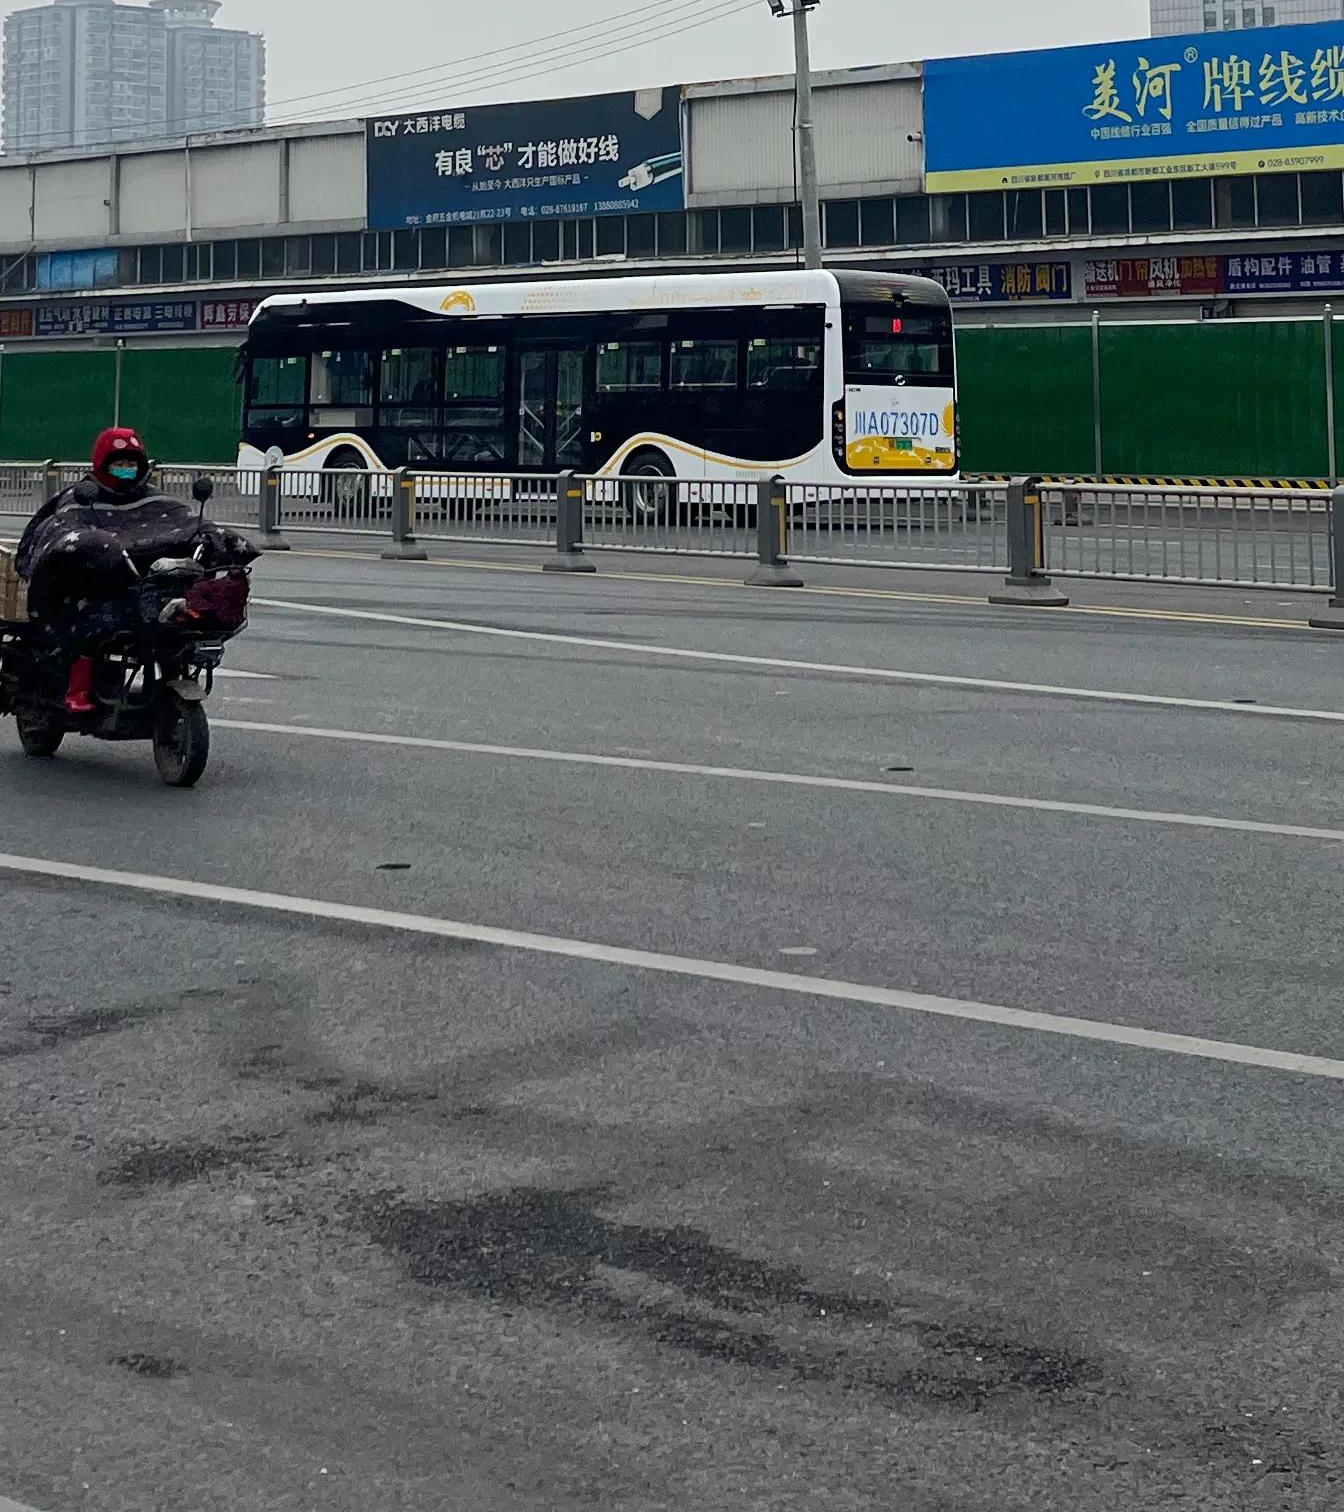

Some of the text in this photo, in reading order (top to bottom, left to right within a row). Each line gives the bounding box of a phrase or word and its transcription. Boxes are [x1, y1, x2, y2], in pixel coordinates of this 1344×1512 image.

[404, 112, 466, 135] 大西洋电缆
[1228, 256, 1293, 277] 盾构配件
[1300, 254, 1332, 275] 油管
[854, 410, 939, 436] 川A07307D
